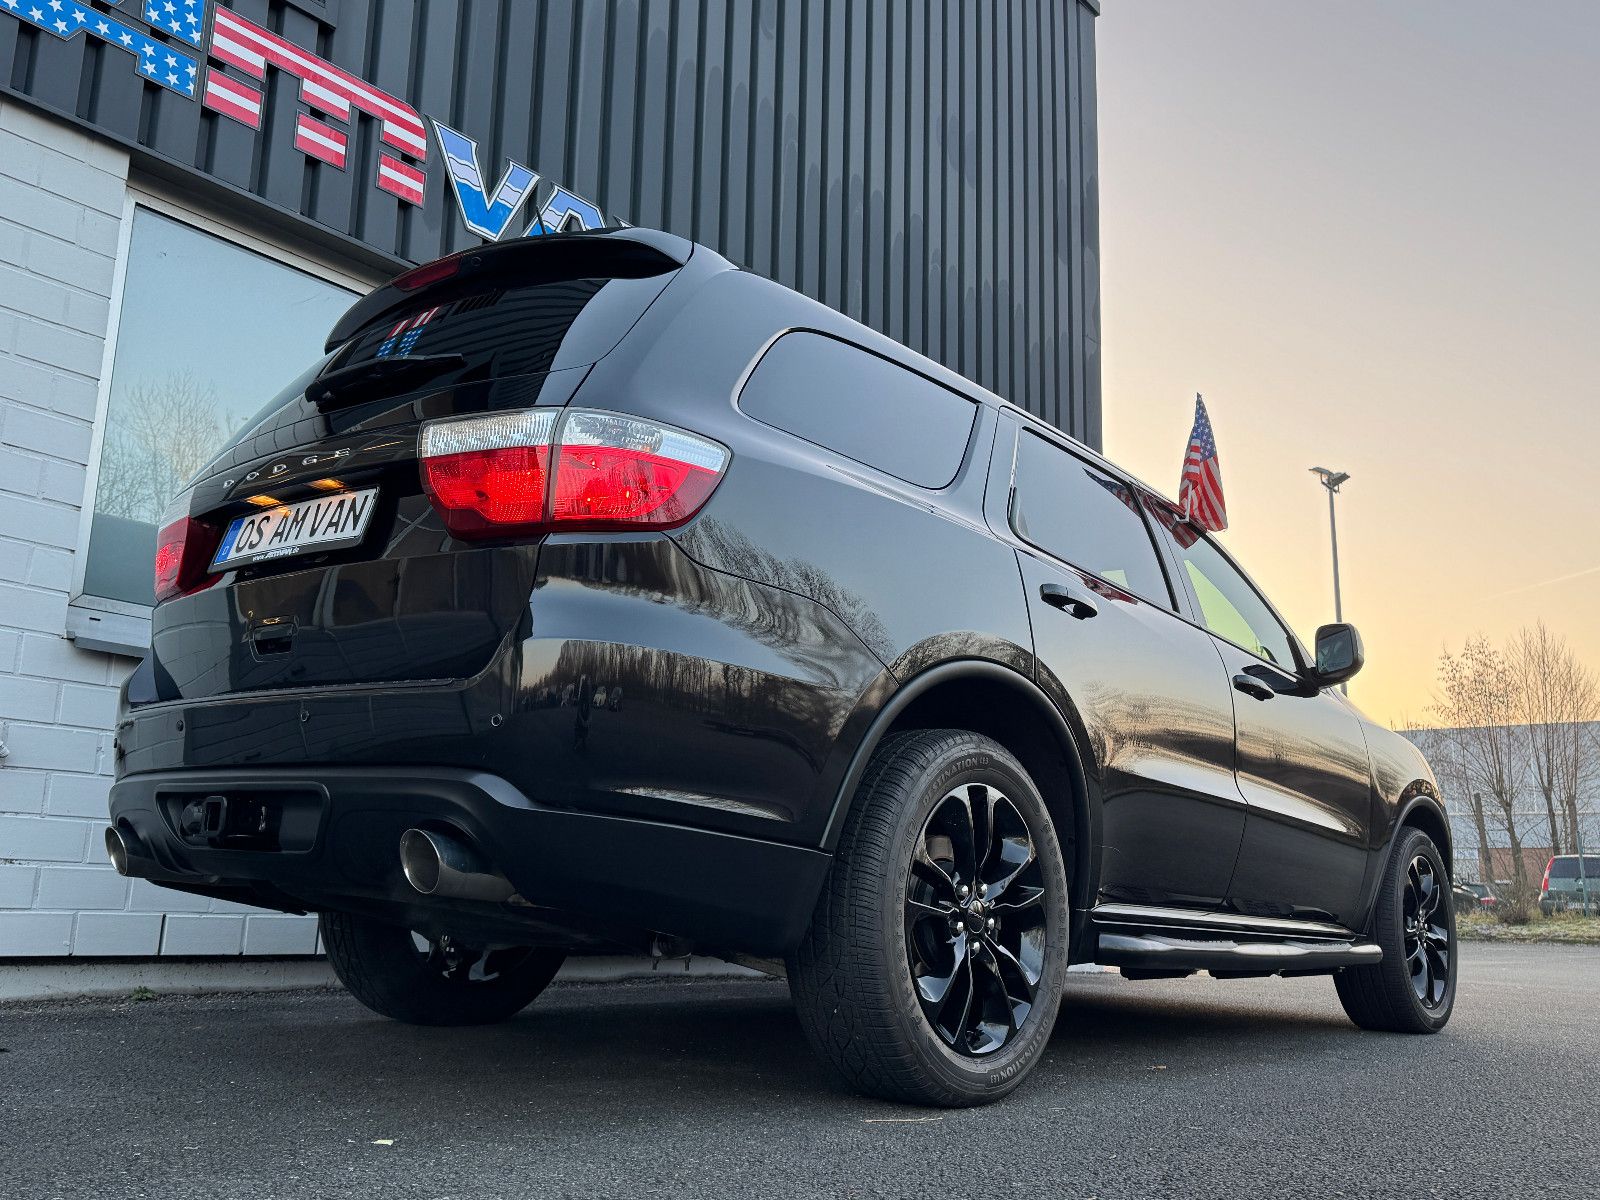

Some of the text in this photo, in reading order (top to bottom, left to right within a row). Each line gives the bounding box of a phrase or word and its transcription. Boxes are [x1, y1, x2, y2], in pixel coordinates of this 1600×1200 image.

[223, 447, 351, 489] DODGE
[235, 515, 271, 554] OS
[922, 757, 978, 807] DESTINATION
[1000, 1017, 1049, 1080] DESTINATION
